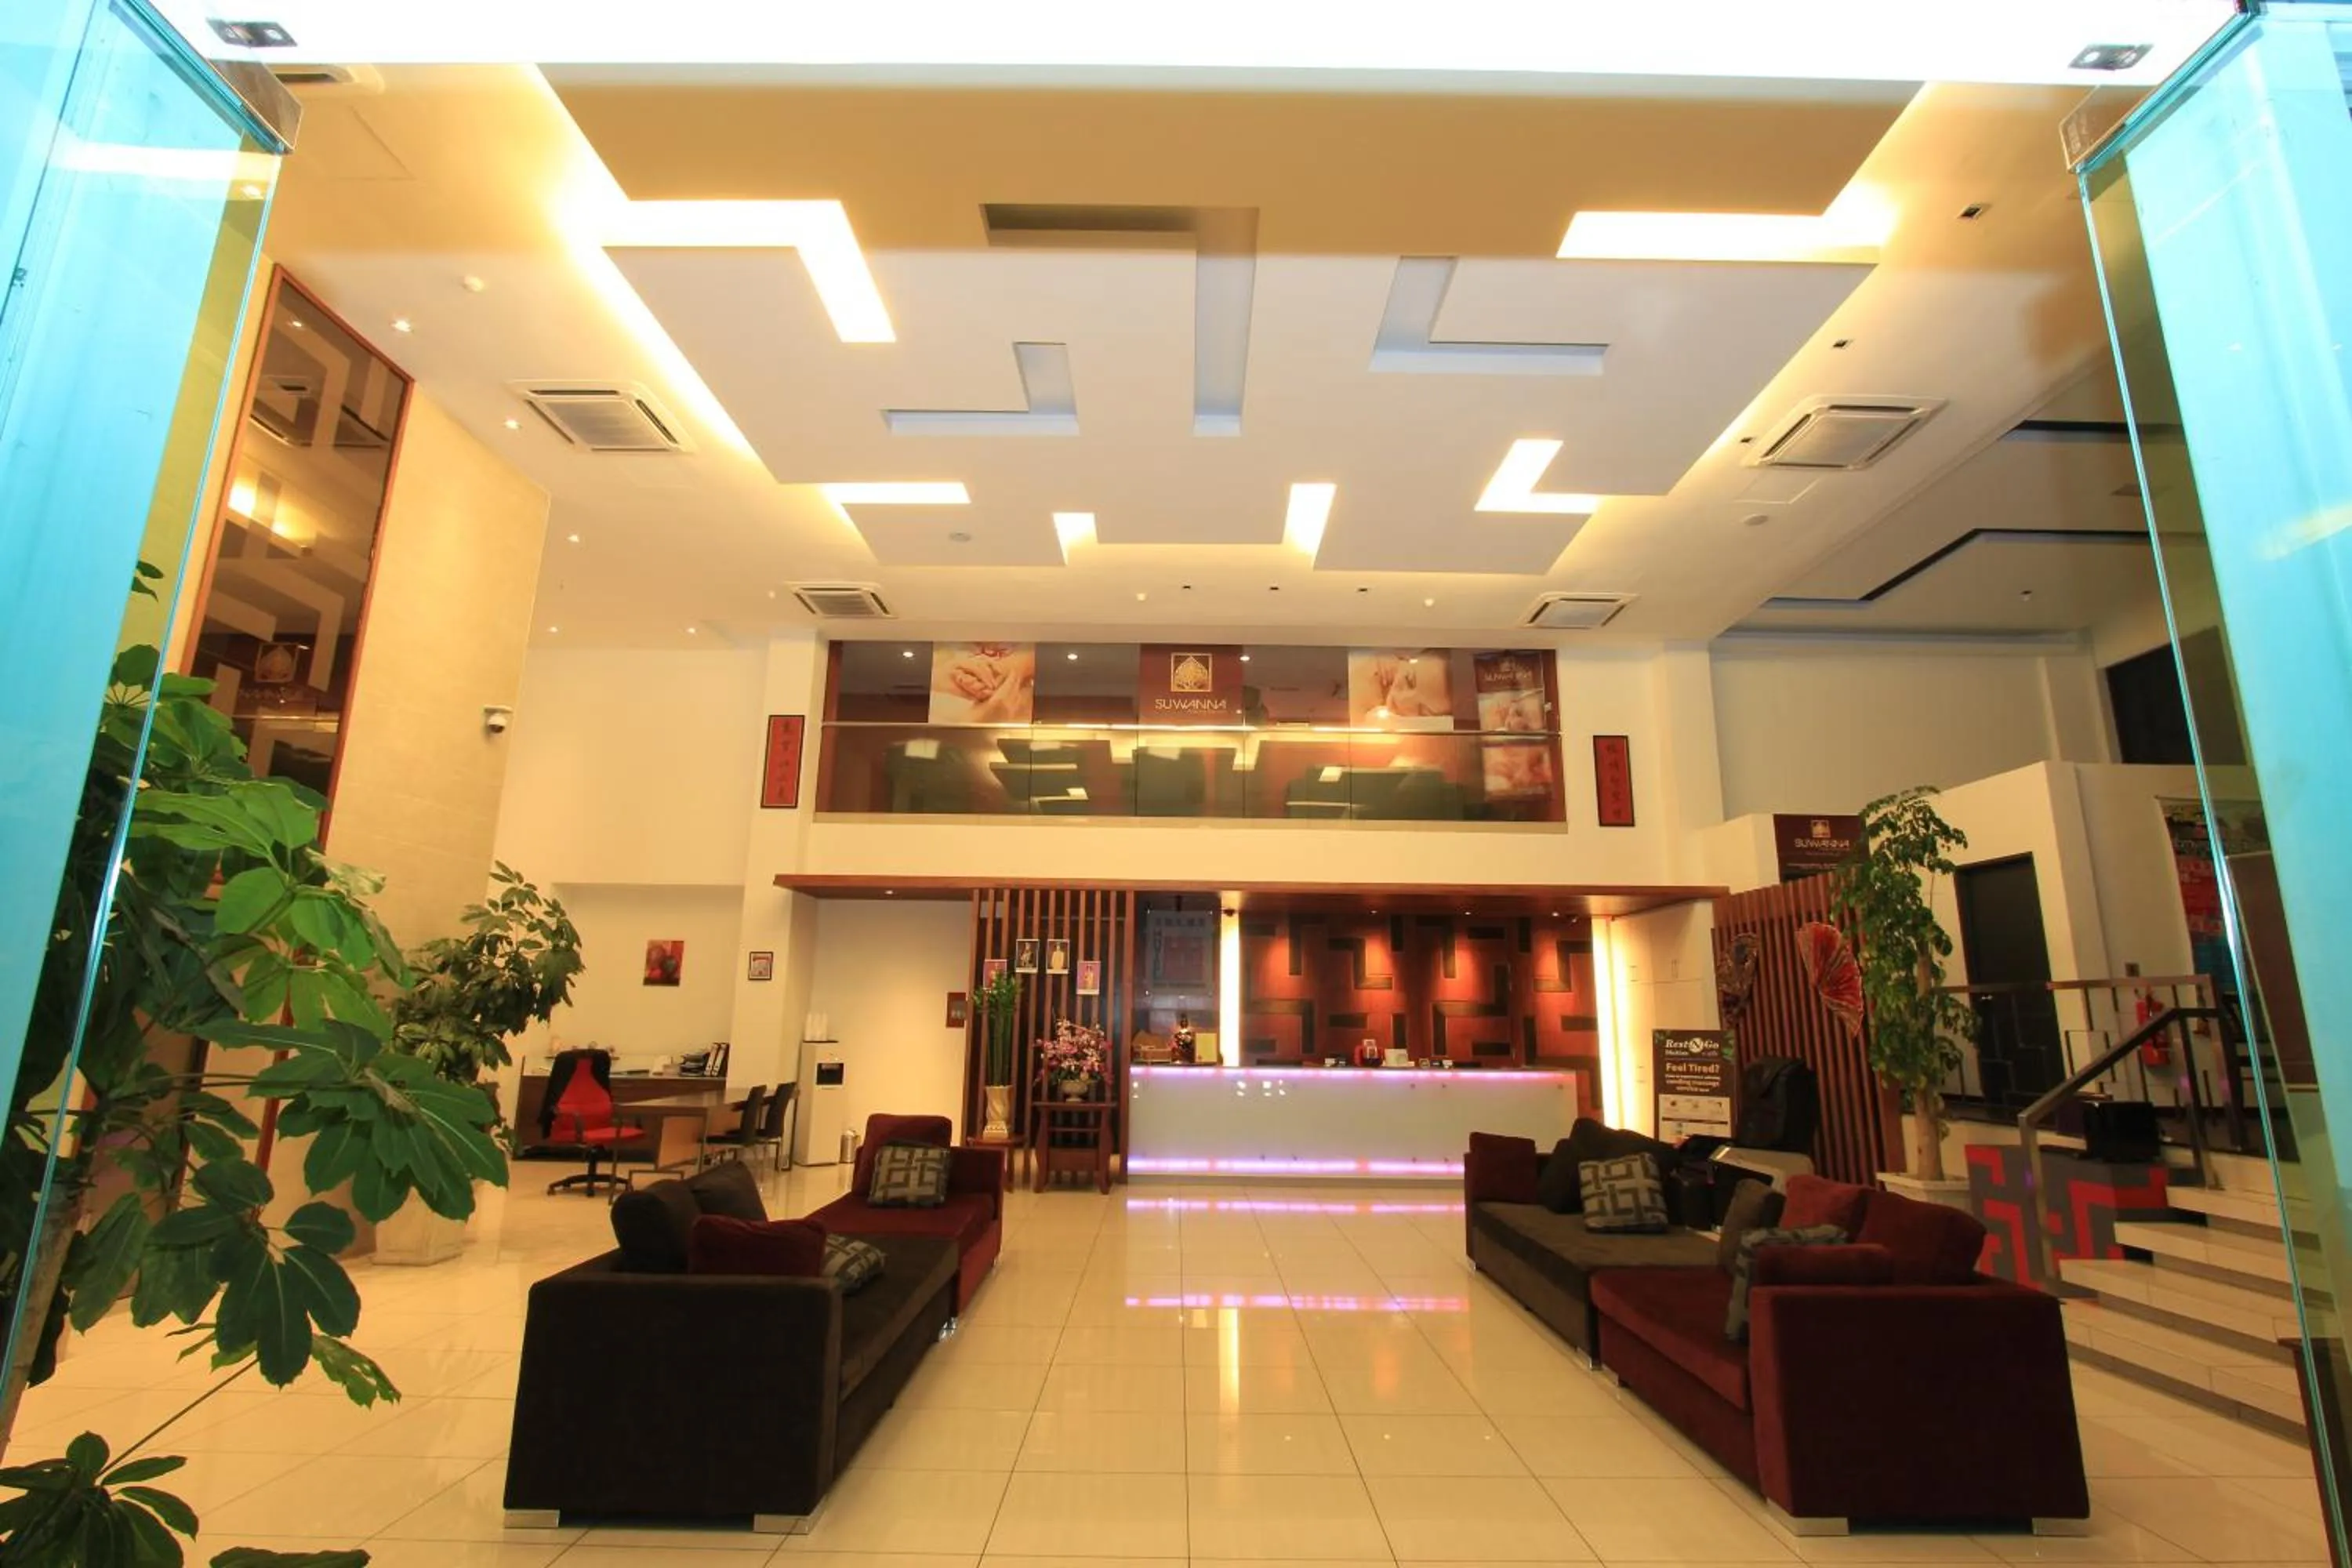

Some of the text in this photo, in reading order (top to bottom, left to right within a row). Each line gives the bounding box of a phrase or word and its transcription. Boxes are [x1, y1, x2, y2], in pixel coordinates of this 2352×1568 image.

[1155, 699, 1227, 710] SUWANNA
[1665, 1062, 1720, 1074] Feel Tired?
